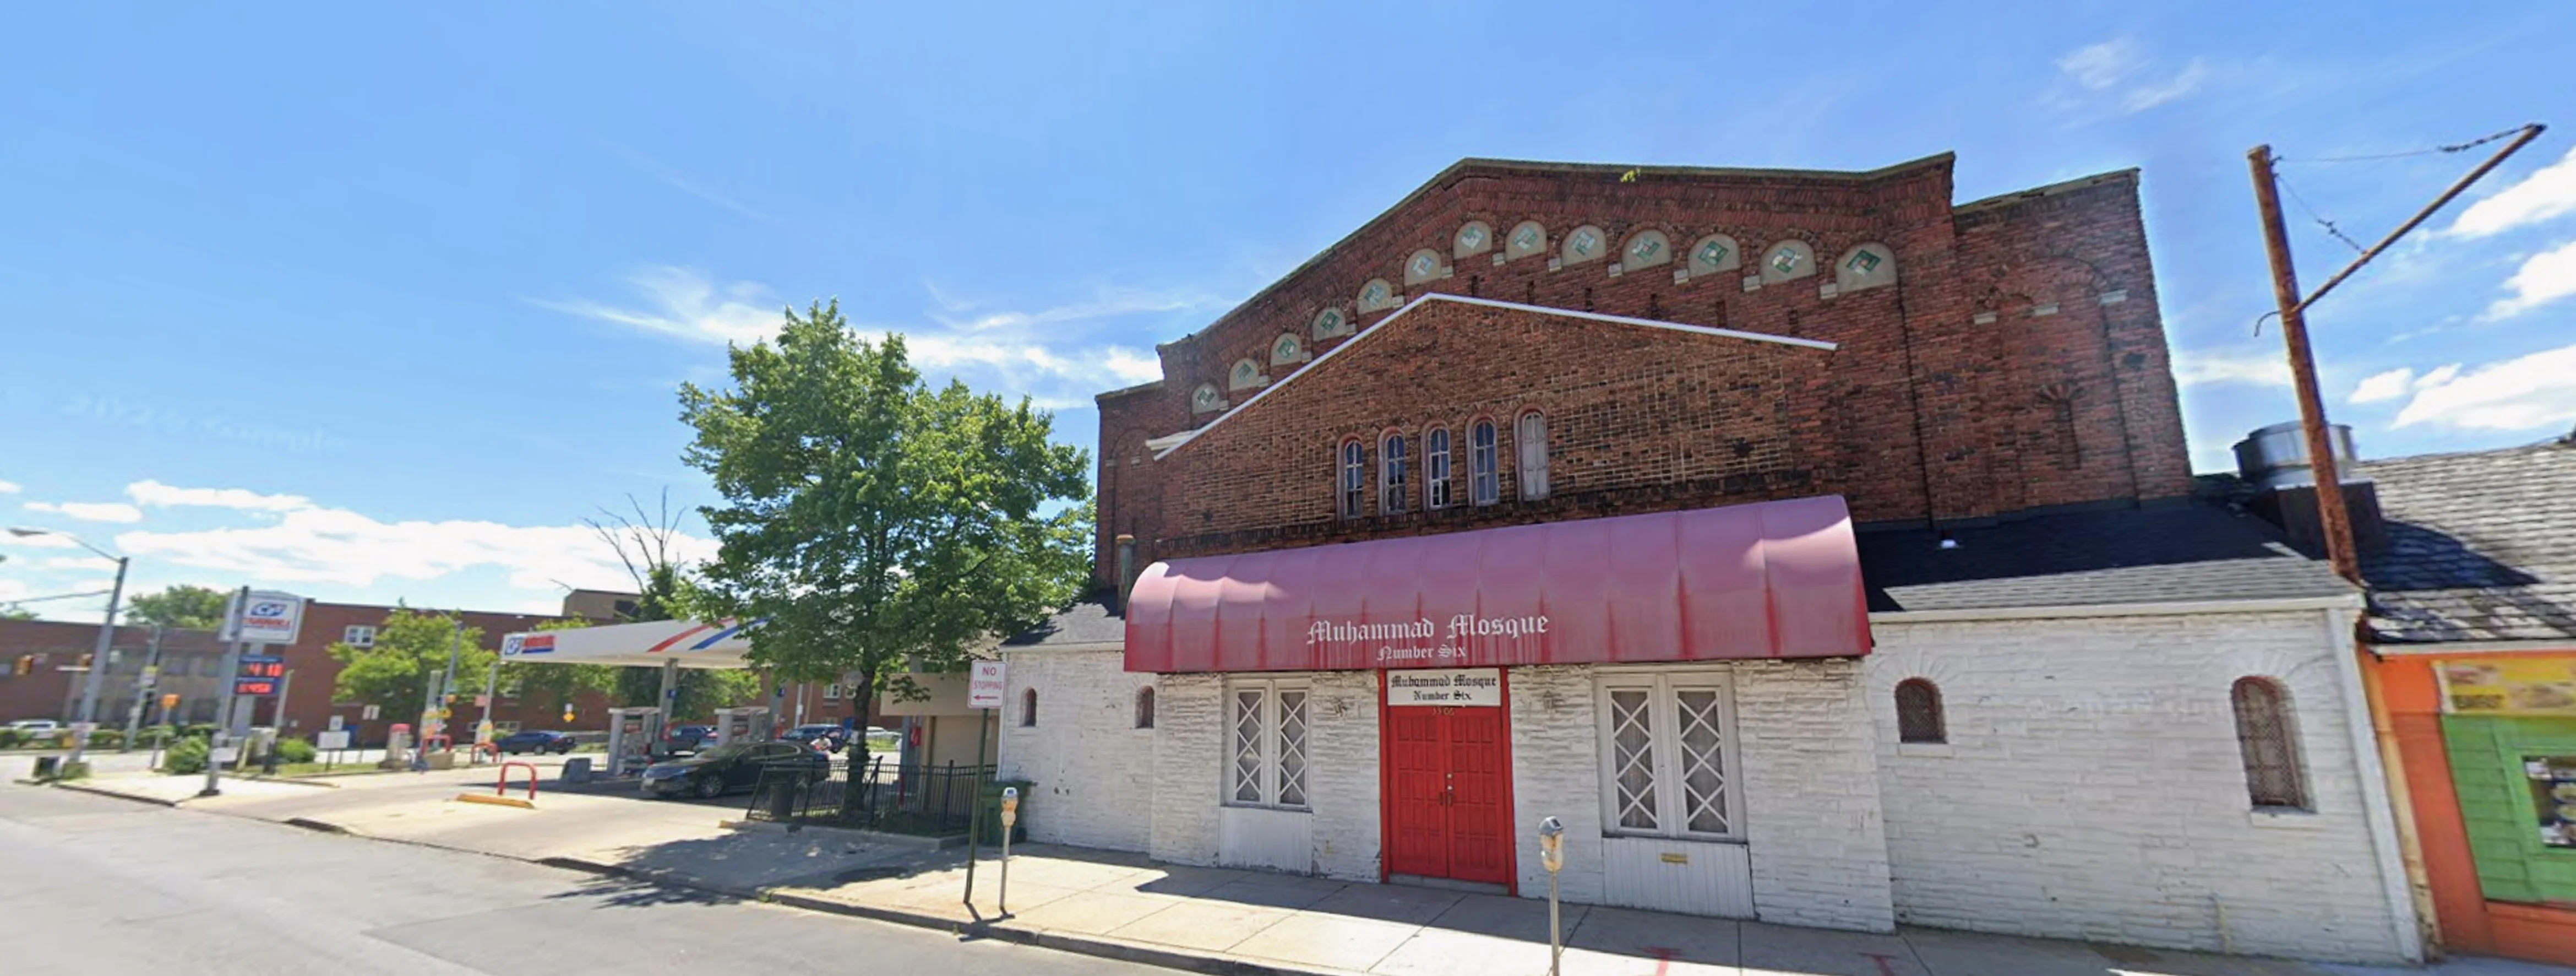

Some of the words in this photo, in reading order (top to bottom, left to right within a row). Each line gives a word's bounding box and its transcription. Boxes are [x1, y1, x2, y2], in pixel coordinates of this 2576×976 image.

[1306, 617, 1434, 644] Muhammad
[1446, 612, 1550, 639] Mosque
[1376, 645, 1434, 661] Number
[1437, 643, 1467, 658] Six
[982, 666, 997, 676] NO
[974, 680, 1003, 690] STOPPING
[1391, 674, 1451, 687] Muhammad
[1453, 674, 1497, 689] Mosque
[1414, 690, 1450, 701] Number
[1453, 690, 1472, 701] Six
